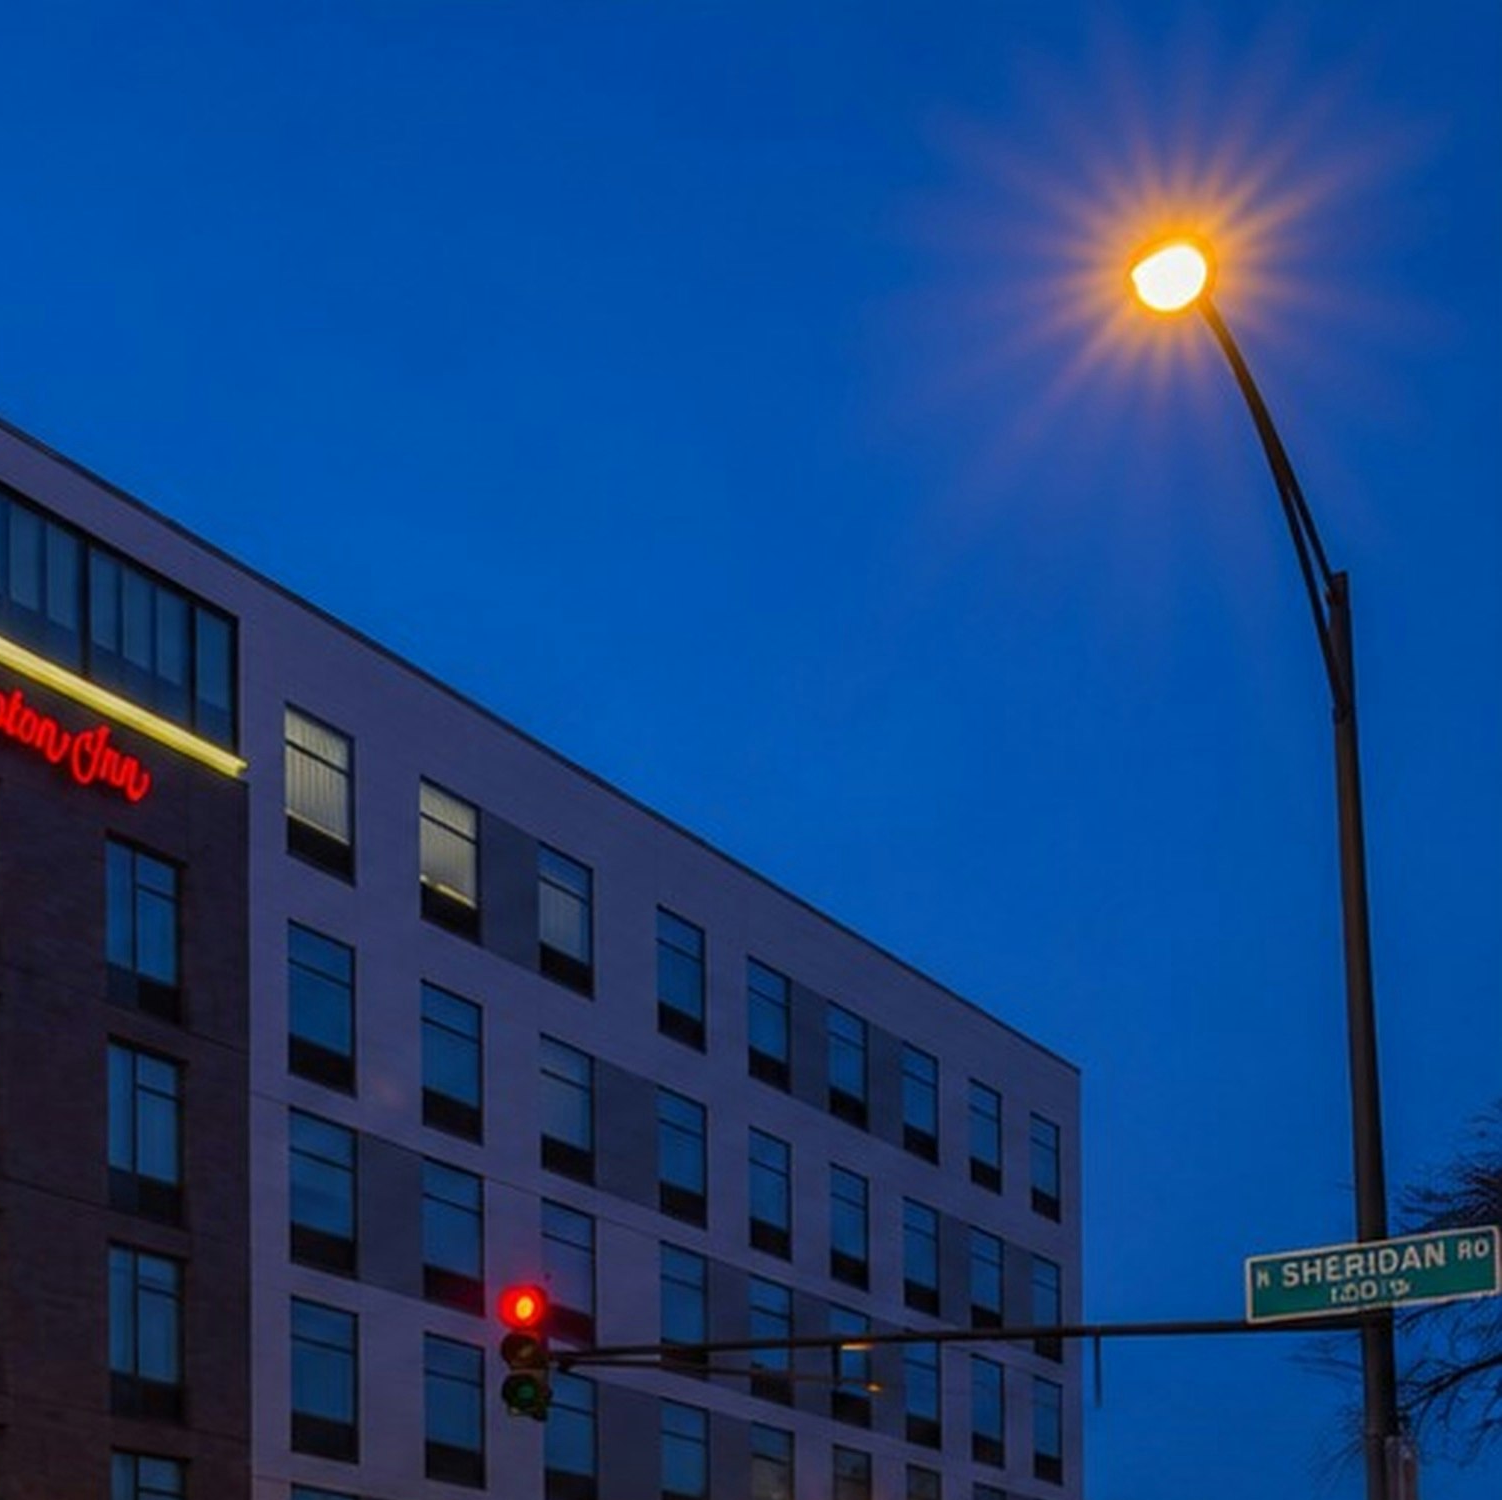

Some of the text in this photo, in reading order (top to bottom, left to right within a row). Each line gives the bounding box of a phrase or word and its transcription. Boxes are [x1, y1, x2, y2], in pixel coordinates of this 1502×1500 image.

[71, 724, 152, 802] Inn
[1281, 1240, 1446, 1287] SHERIDAN
[1457, 1237, 1491, 1261] RD
